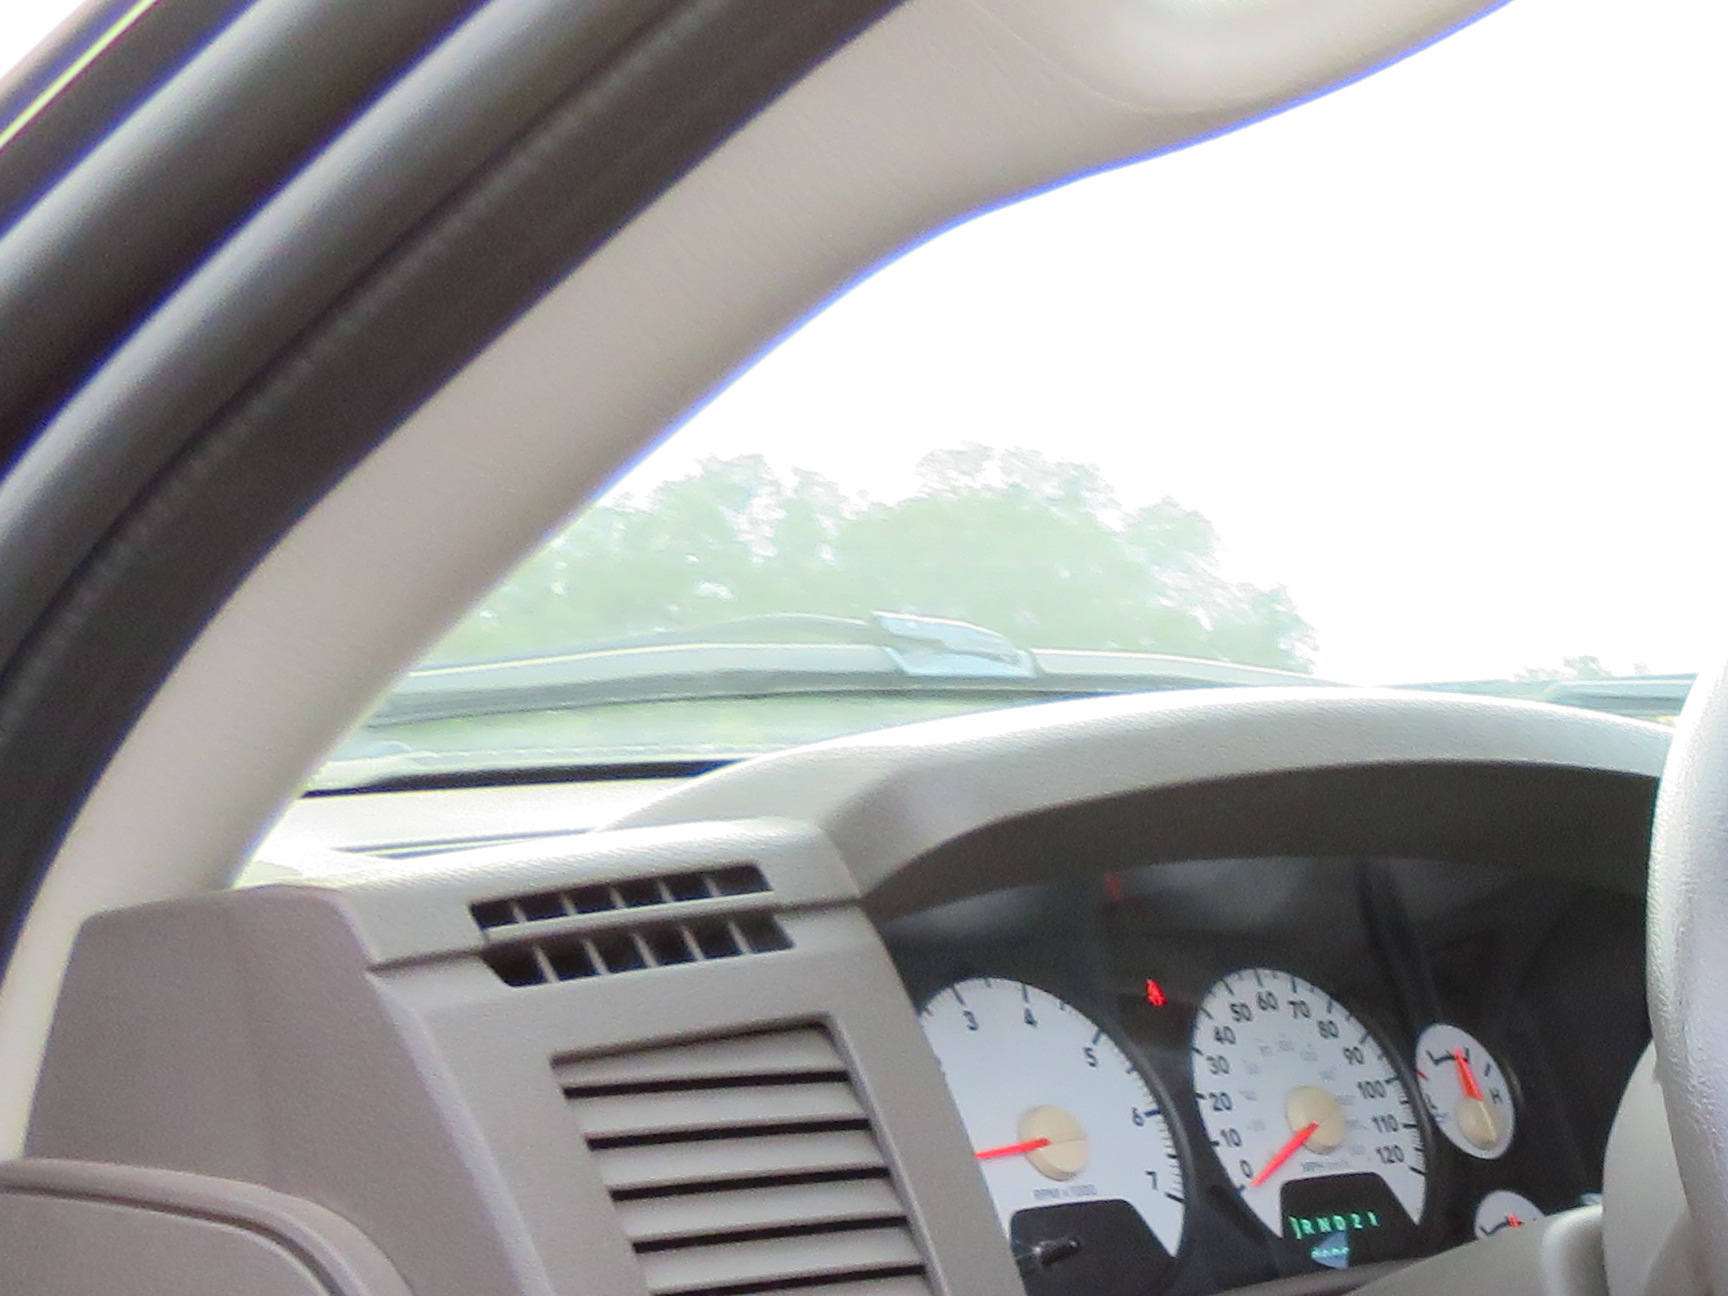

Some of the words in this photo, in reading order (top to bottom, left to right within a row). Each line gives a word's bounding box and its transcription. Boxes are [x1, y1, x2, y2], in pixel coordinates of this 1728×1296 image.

[1257, 990, 1278, 1011] 60
[1286, 1000, 1310, 1019] 70
[963, 1010, 978, 1031] 3
[1024, 1008, 1037, 1027] 4
[1230, 1003, 1253, 1022] 50
[1213, 1025, 1236, 1045] 40
[1317, 1020, 1339, 1039] 80
[1083, 1047, 1098, 1067] 5
[1206, 1055, 1230, 1075] 30
[1343, 1047, 1364, 1065] 90
[1357, 1080, 1386, 1099] 100
[1208, 1092, 1232, 1111] 20
[1132, 1107, 1144, 1126] 6
[1372, 1114, 1398, 1133] 110
[1221, 1128, 1242, 1148] 10
[1376, 1144, 1405, 1164] 120
[1145, 1170, 1158, 1191] 7
